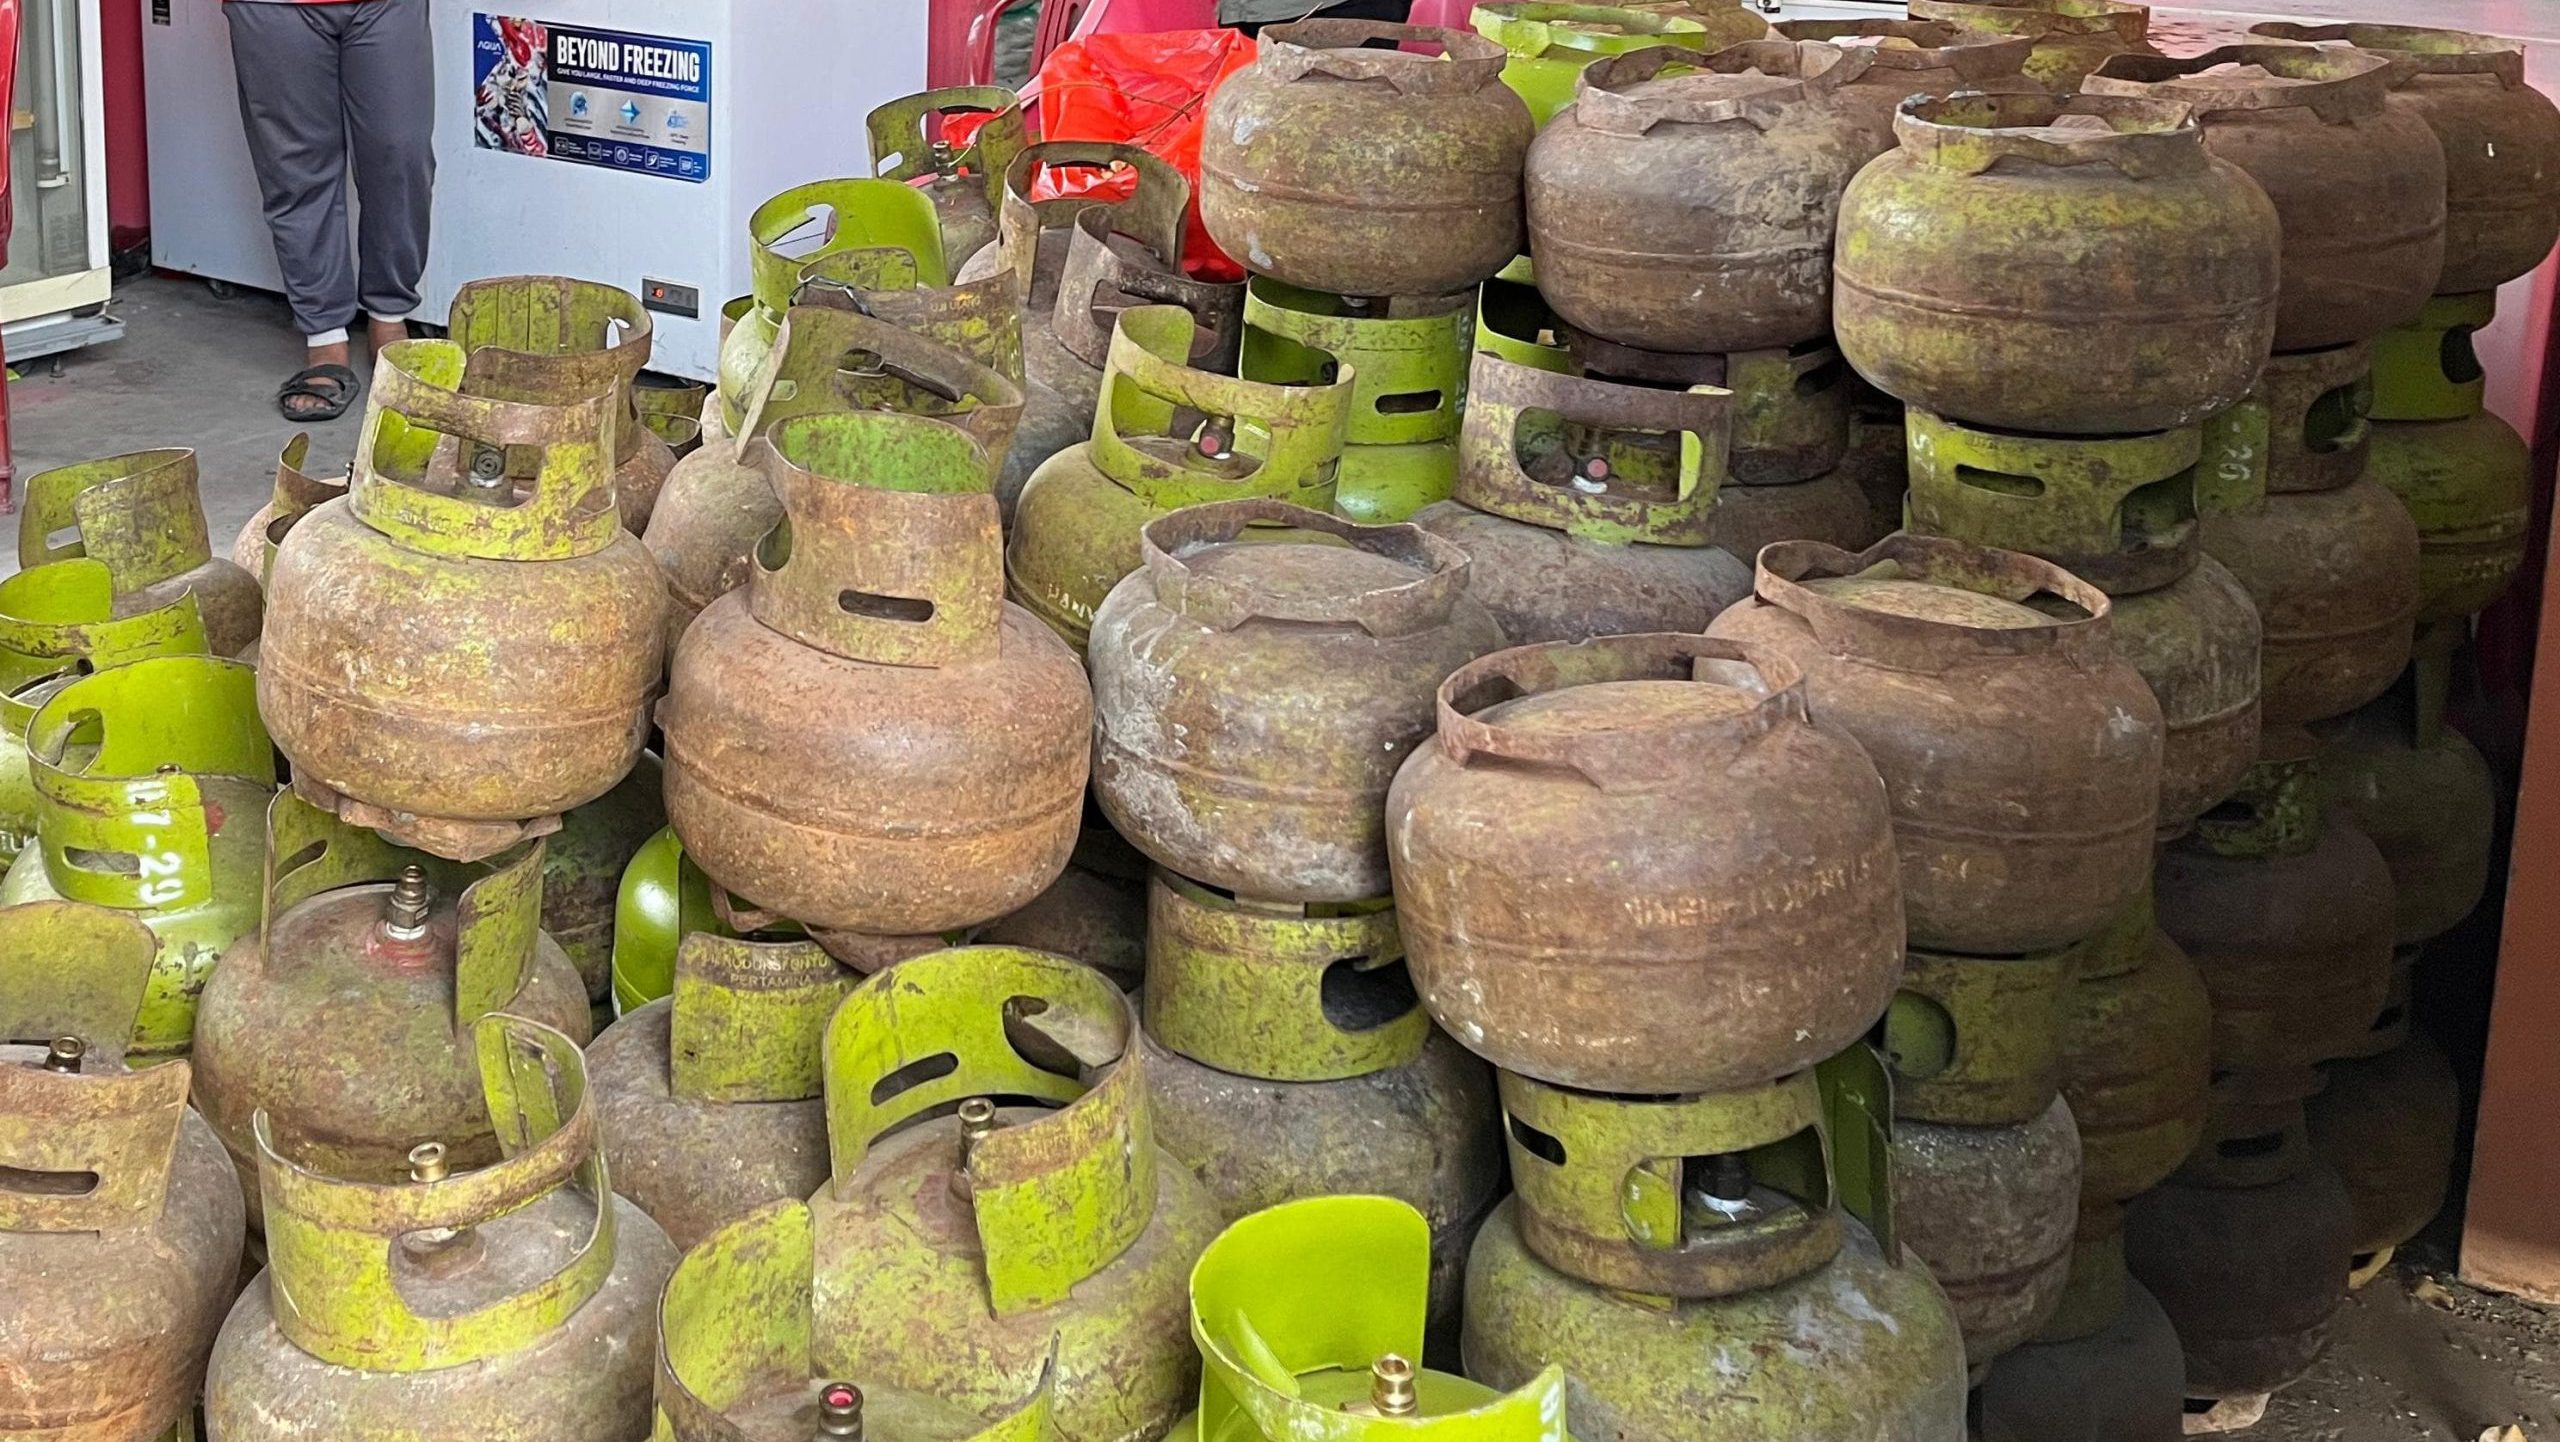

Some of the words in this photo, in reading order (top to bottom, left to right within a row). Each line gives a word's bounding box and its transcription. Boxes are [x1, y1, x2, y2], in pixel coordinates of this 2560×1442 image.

[477, 40, 502, 51] AQUA
[557, 35, 620, 71] BEYOND
[623, 43, 700, 83] FREEZING
[557, 67, 570, 76] GIVE
[571, 69, 583, 77] YOU
[603, 73, 623, 83] FASTER
[624, 76, 636, 85] AND
[637, 78, 652, 87] DEEP
[652, 80, 680, 90] FREEZING
[681, 84, 700, 93] FORCE
[729, 973, 812, 988] PERTAMINA
